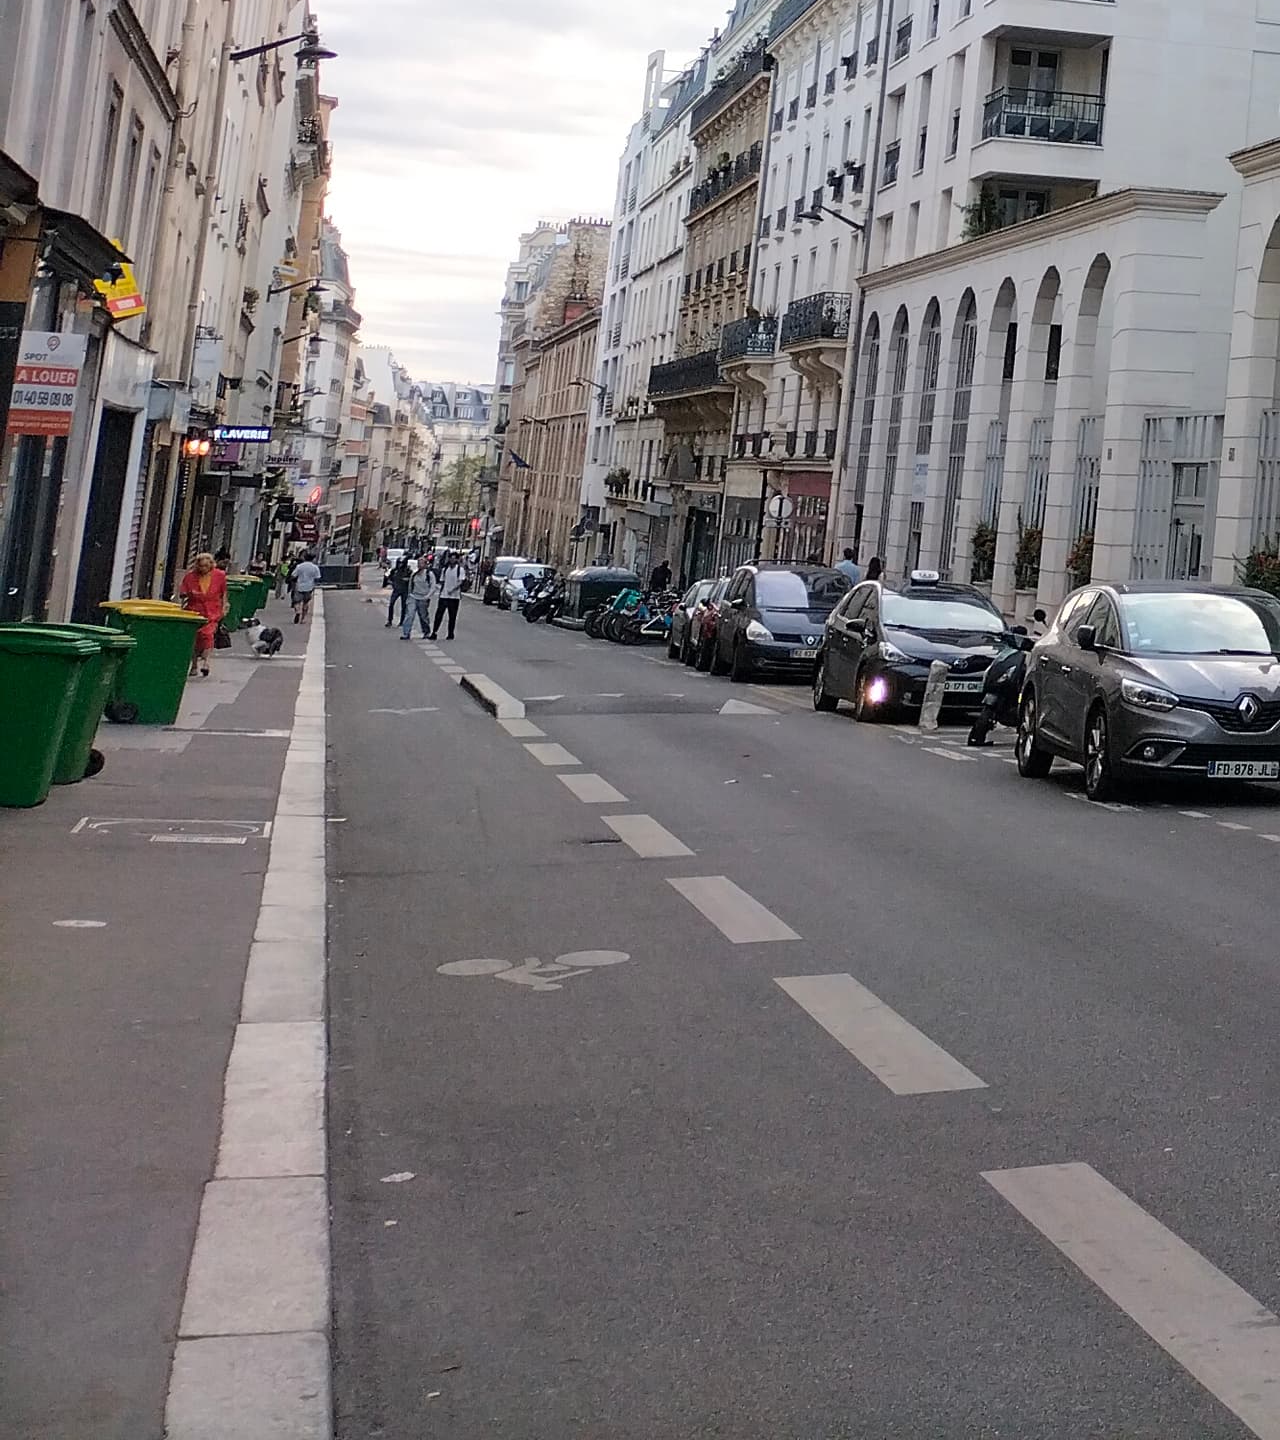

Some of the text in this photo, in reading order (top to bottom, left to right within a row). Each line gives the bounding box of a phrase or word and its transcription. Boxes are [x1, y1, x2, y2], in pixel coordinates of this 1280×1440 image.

[24, 353, 48, 361] SPOT
[17, 369, 76, 385] A LOUER
[221, 428, 269, 440] LAVERIE
